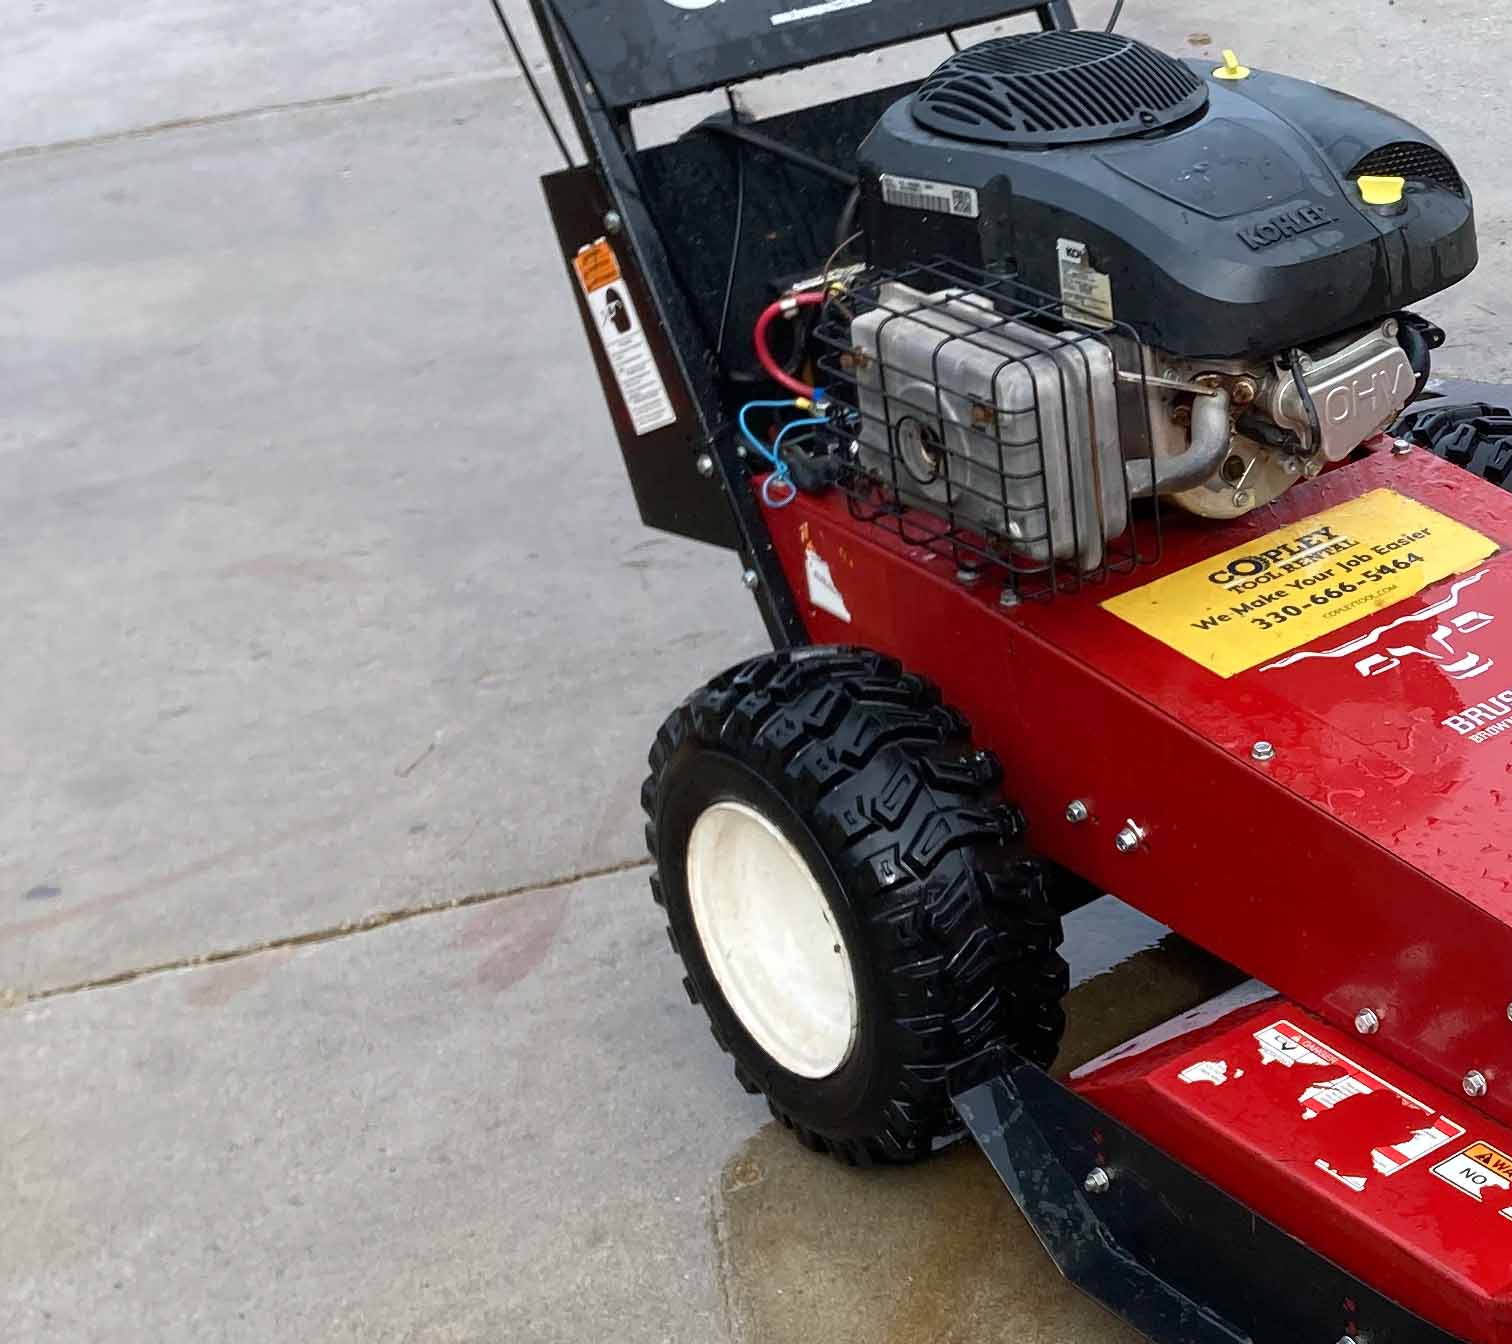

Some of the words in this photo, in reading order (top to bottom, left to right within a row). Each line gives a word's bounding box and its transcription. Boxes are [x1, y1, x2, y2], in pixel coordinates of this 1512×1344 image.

[1236, 206, 1337, 251] KOHLER
[1325, 362, 1404, 425] OHV
[1191, 613, 1232, 631] We
[1230, 589, 1289, 617] Make
[1285, 568, 1335, 590] Your
[1336, 554, 1373, 573] Job
[1370, 527, 1431, 555] Easier
[1208, 526, 1338, 585] COPLEY
[1228, 570, 1282, 595] TOOL
[1279, 539, 1360, 574] RENTAL
[1251, 552, 1424, 630] 330-666-5464
[1459, 1167, 1487, 1185] NO
